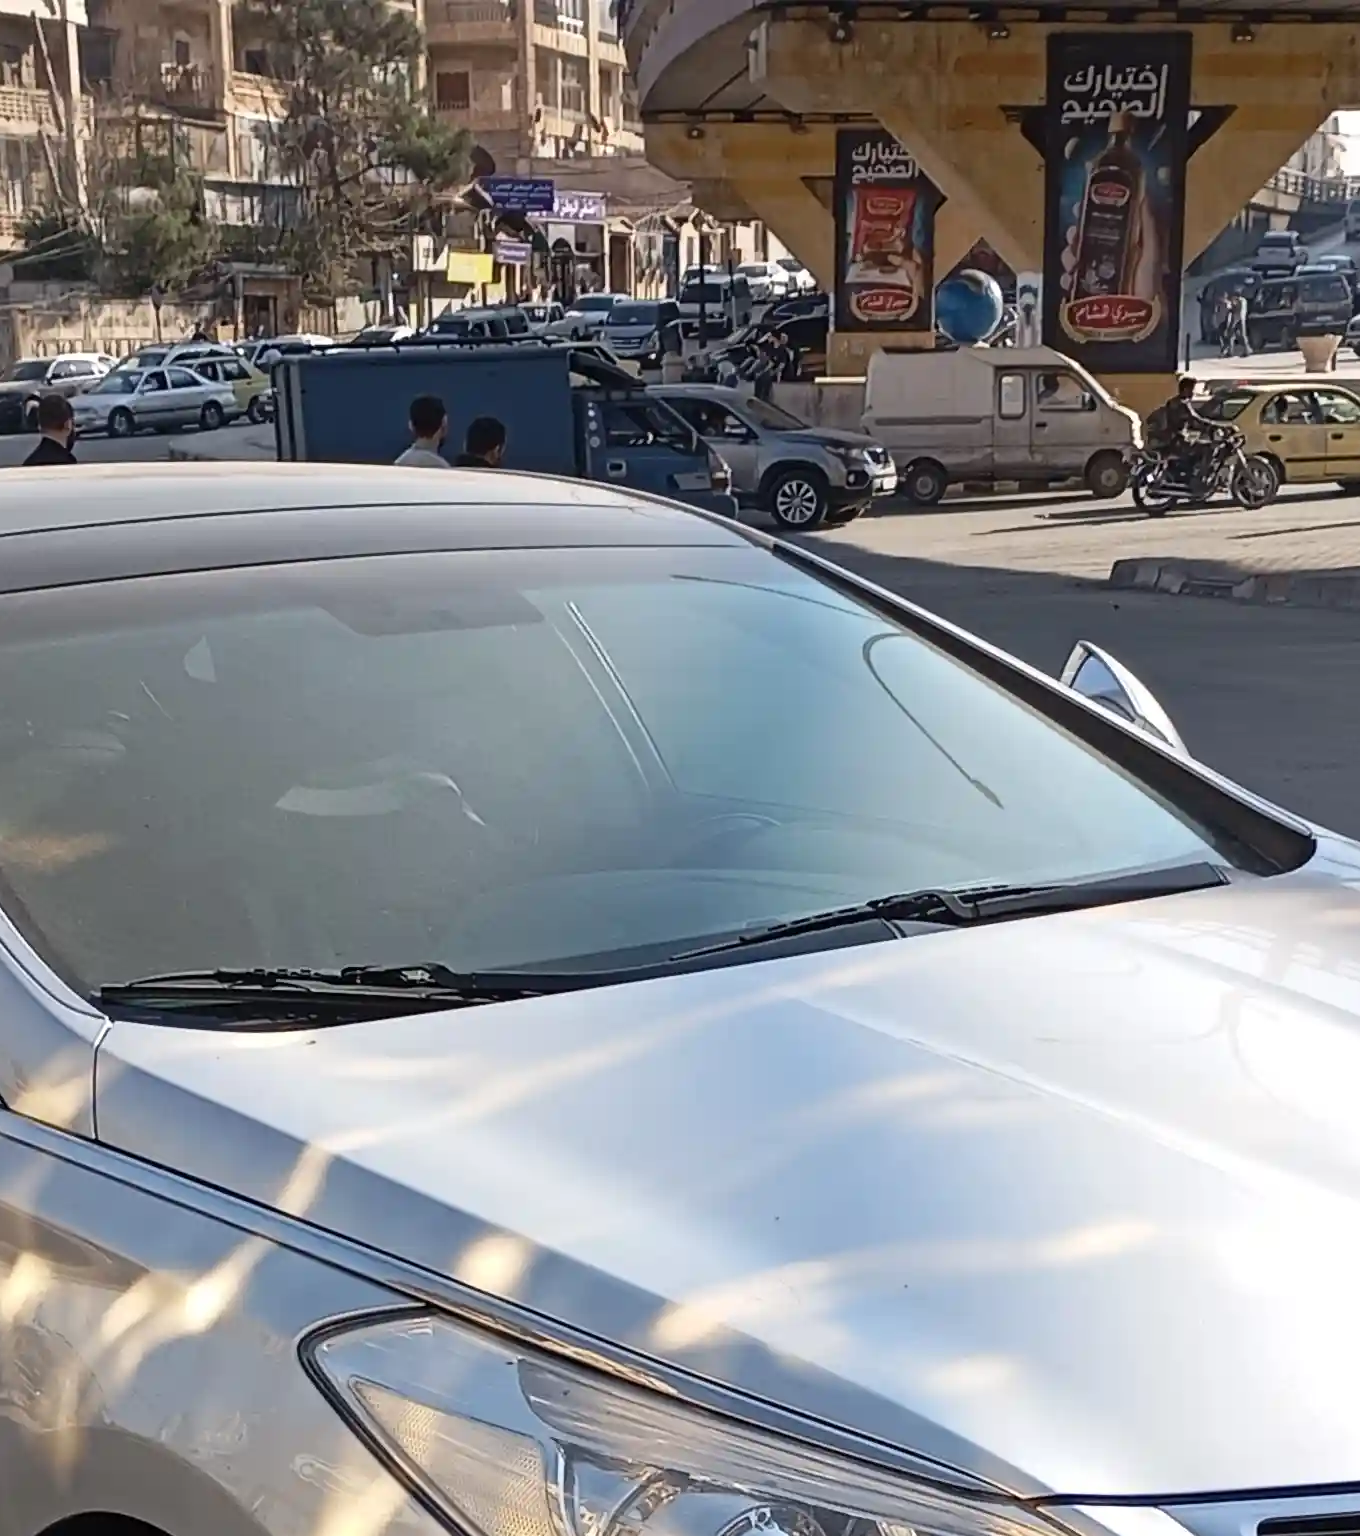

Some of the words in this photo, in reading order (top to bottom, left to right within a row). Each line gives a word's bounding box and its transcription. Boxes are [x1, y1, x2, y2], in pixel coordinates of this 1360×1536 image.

[1063, 64, 1169, 99] اختيارك
[1061, 91, 1167, 125] الصحيح
[1074, 304, 1110, 322] هشام
[1111, 304, 1147, 325] سيدي
